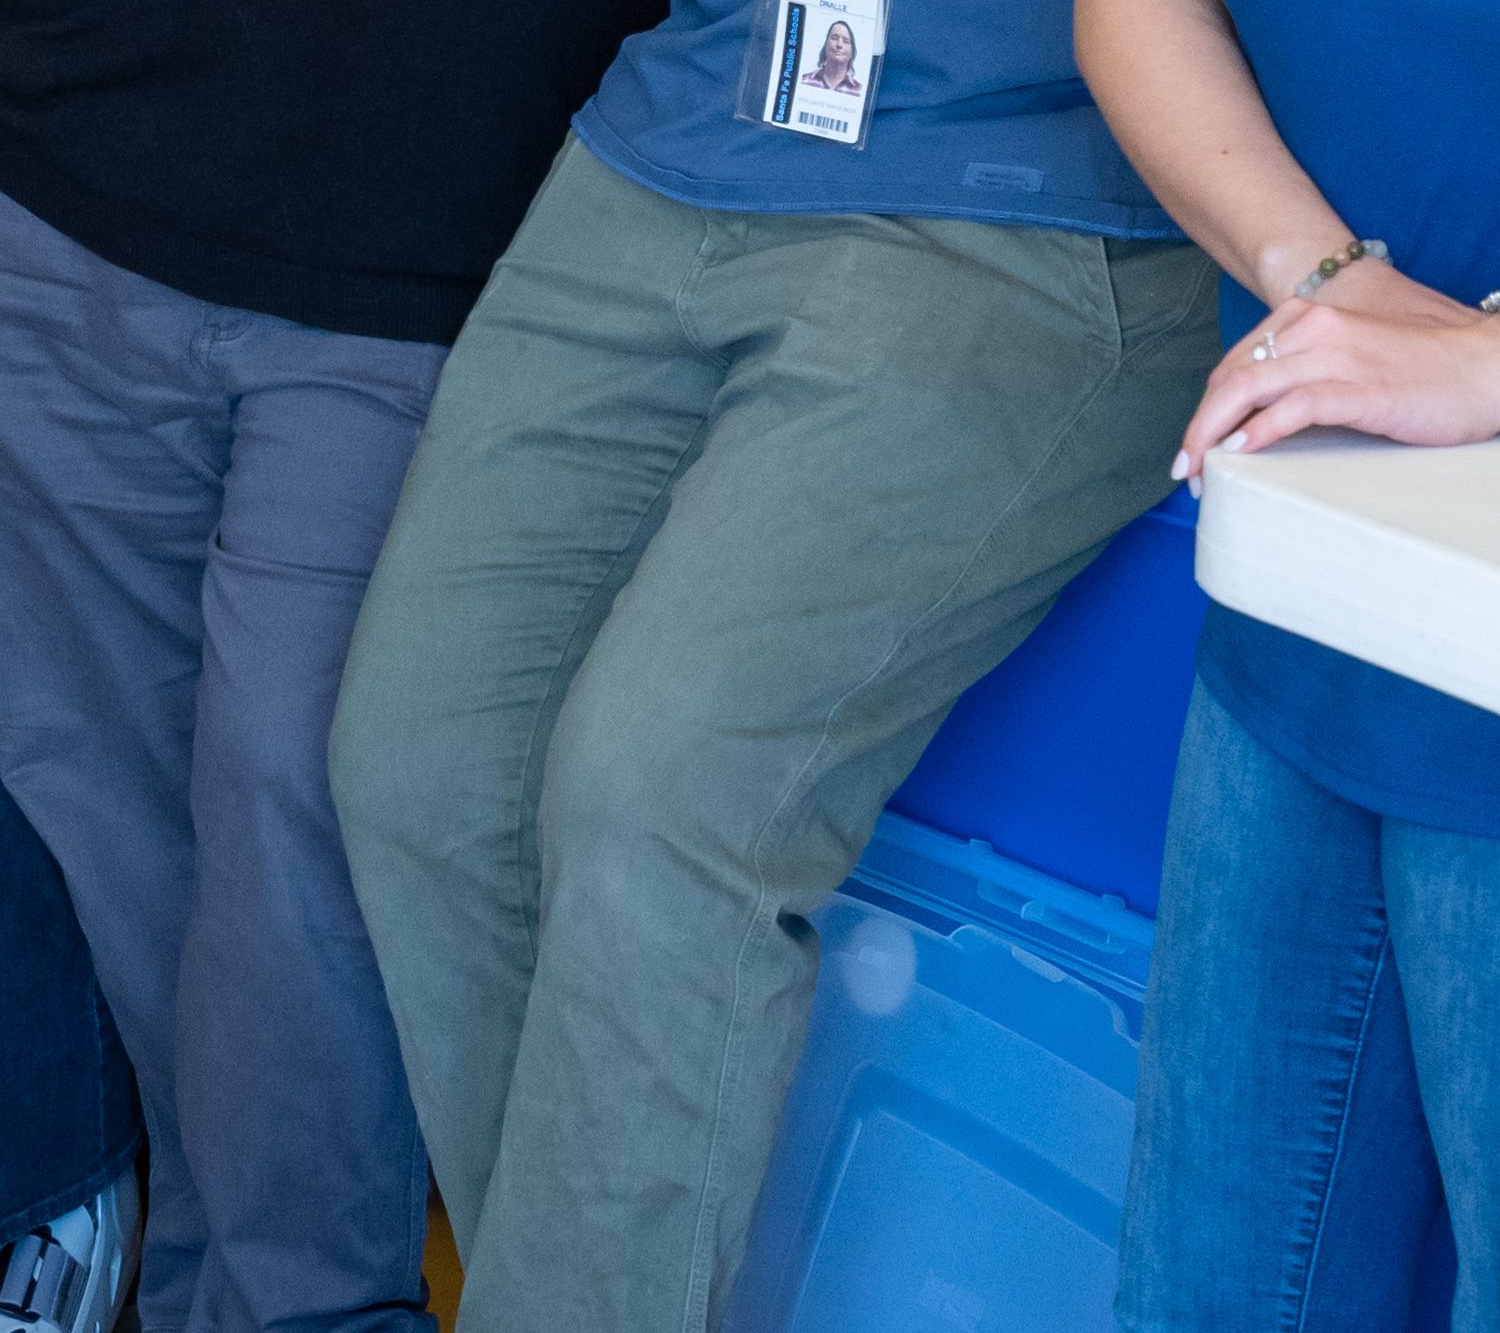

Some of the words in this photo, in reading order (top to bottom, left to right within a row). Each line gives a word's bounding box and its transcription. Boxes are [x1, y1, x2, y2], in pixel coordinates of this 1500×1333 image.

[788, 7, 801, 47] Schools
[783, 48, 796, 79] Public
[780, 79, 791, 93] Fe
[775, 94, 788, 121] Santa
